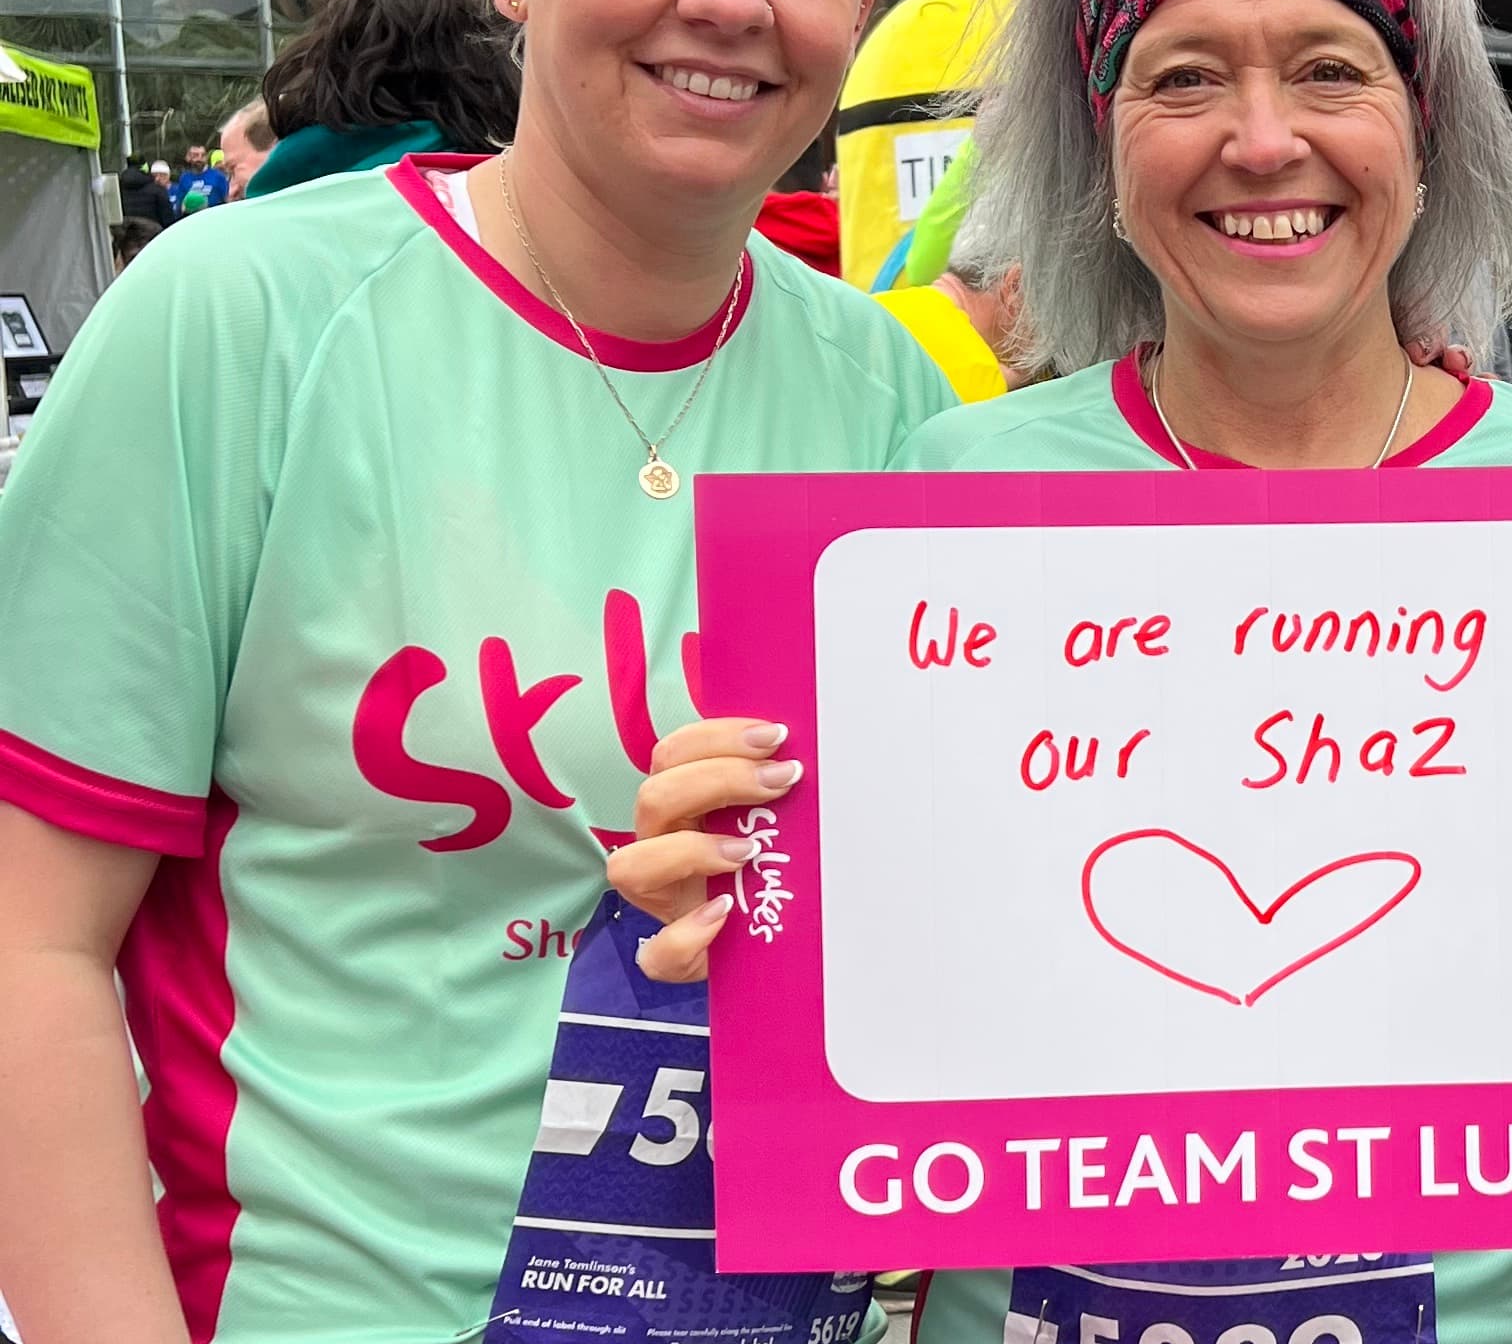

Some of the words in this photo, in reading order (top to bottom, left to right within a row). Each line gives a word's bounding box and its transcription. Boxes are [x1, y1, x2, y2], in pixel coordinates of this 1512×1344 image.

[908, 599, 997, 670] We
[1063, 613, 1172, 667] are
[1234, 604, 1487, 691] running
[352, 635, 583, 853] St
[1020, 729, 1151, 791] our
[838, 1141, 985, 1216] GO
[1005, 1130, 1257, 1211] TEAM
[1287, 1126, 1392, 1201] ST
[521, 1269, 574, 1292] RUN
[576, 1274, 624, 1297] FOR
[627, 1279, 667, 1299] ALL
[528, 1255, 560, 1269] Jane
[563, 1258, 636, 1275] Tomlinson's
